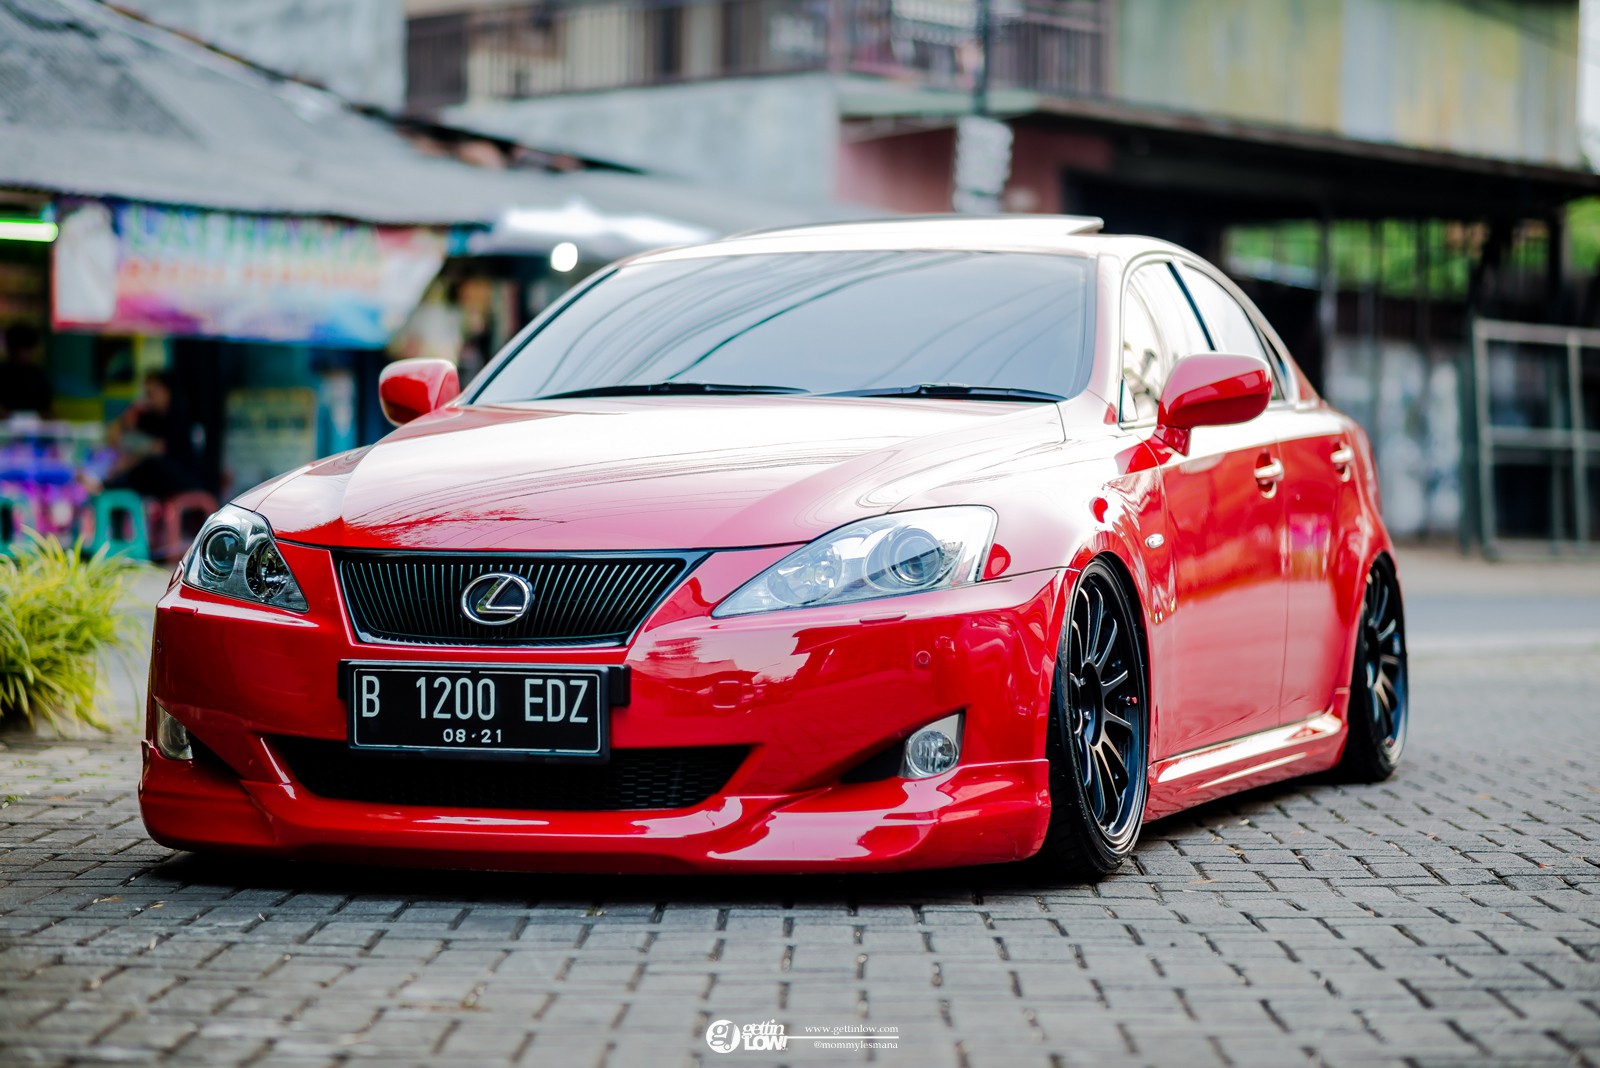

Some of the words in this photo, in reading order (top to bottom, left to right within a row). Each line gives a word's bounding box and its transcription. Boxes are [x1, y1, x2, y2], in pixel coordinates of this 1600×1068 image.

[361, 675, 381, 718] B
[415, 676, 496, 721] 1200
[524, 678, 589, 723] EDZ
